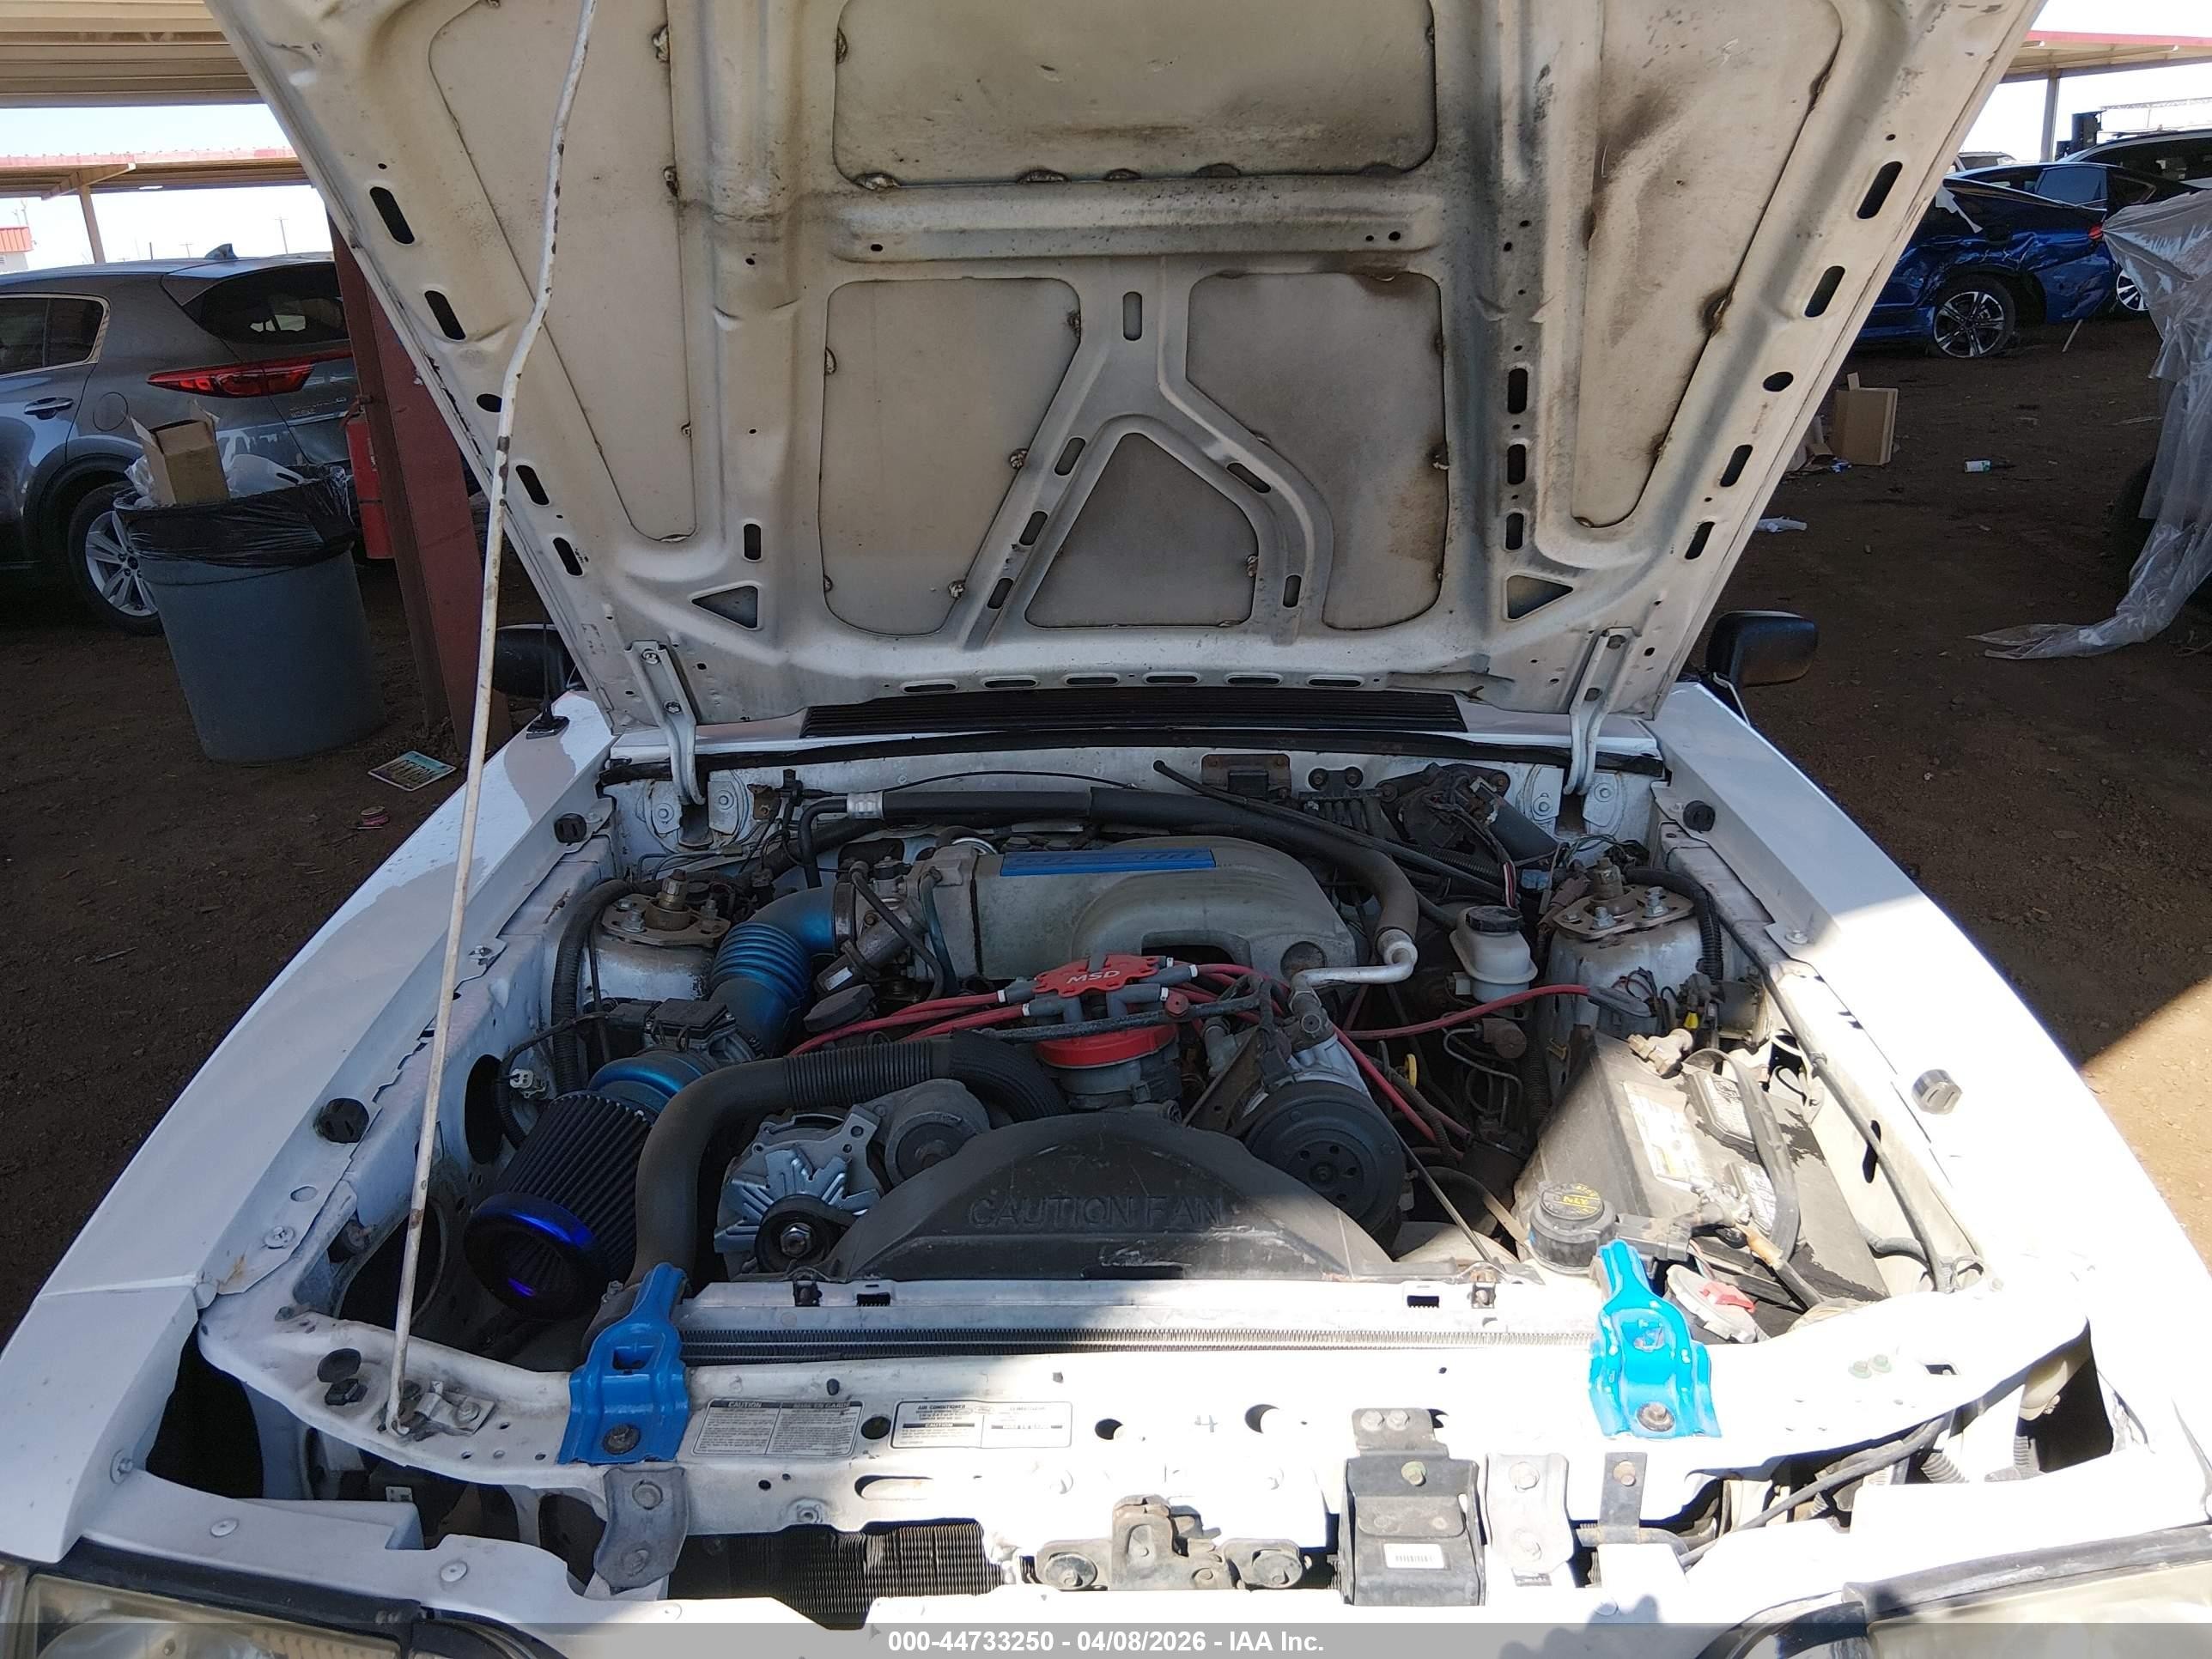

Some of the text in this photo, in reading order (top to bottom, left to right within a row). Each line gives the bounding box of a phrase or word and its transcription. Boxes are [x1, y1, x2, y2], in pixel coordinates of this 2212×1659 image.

[1066, 970, 1121, 984] MSD
[969, 1194, 1225, 1226] CAUTION FAN
